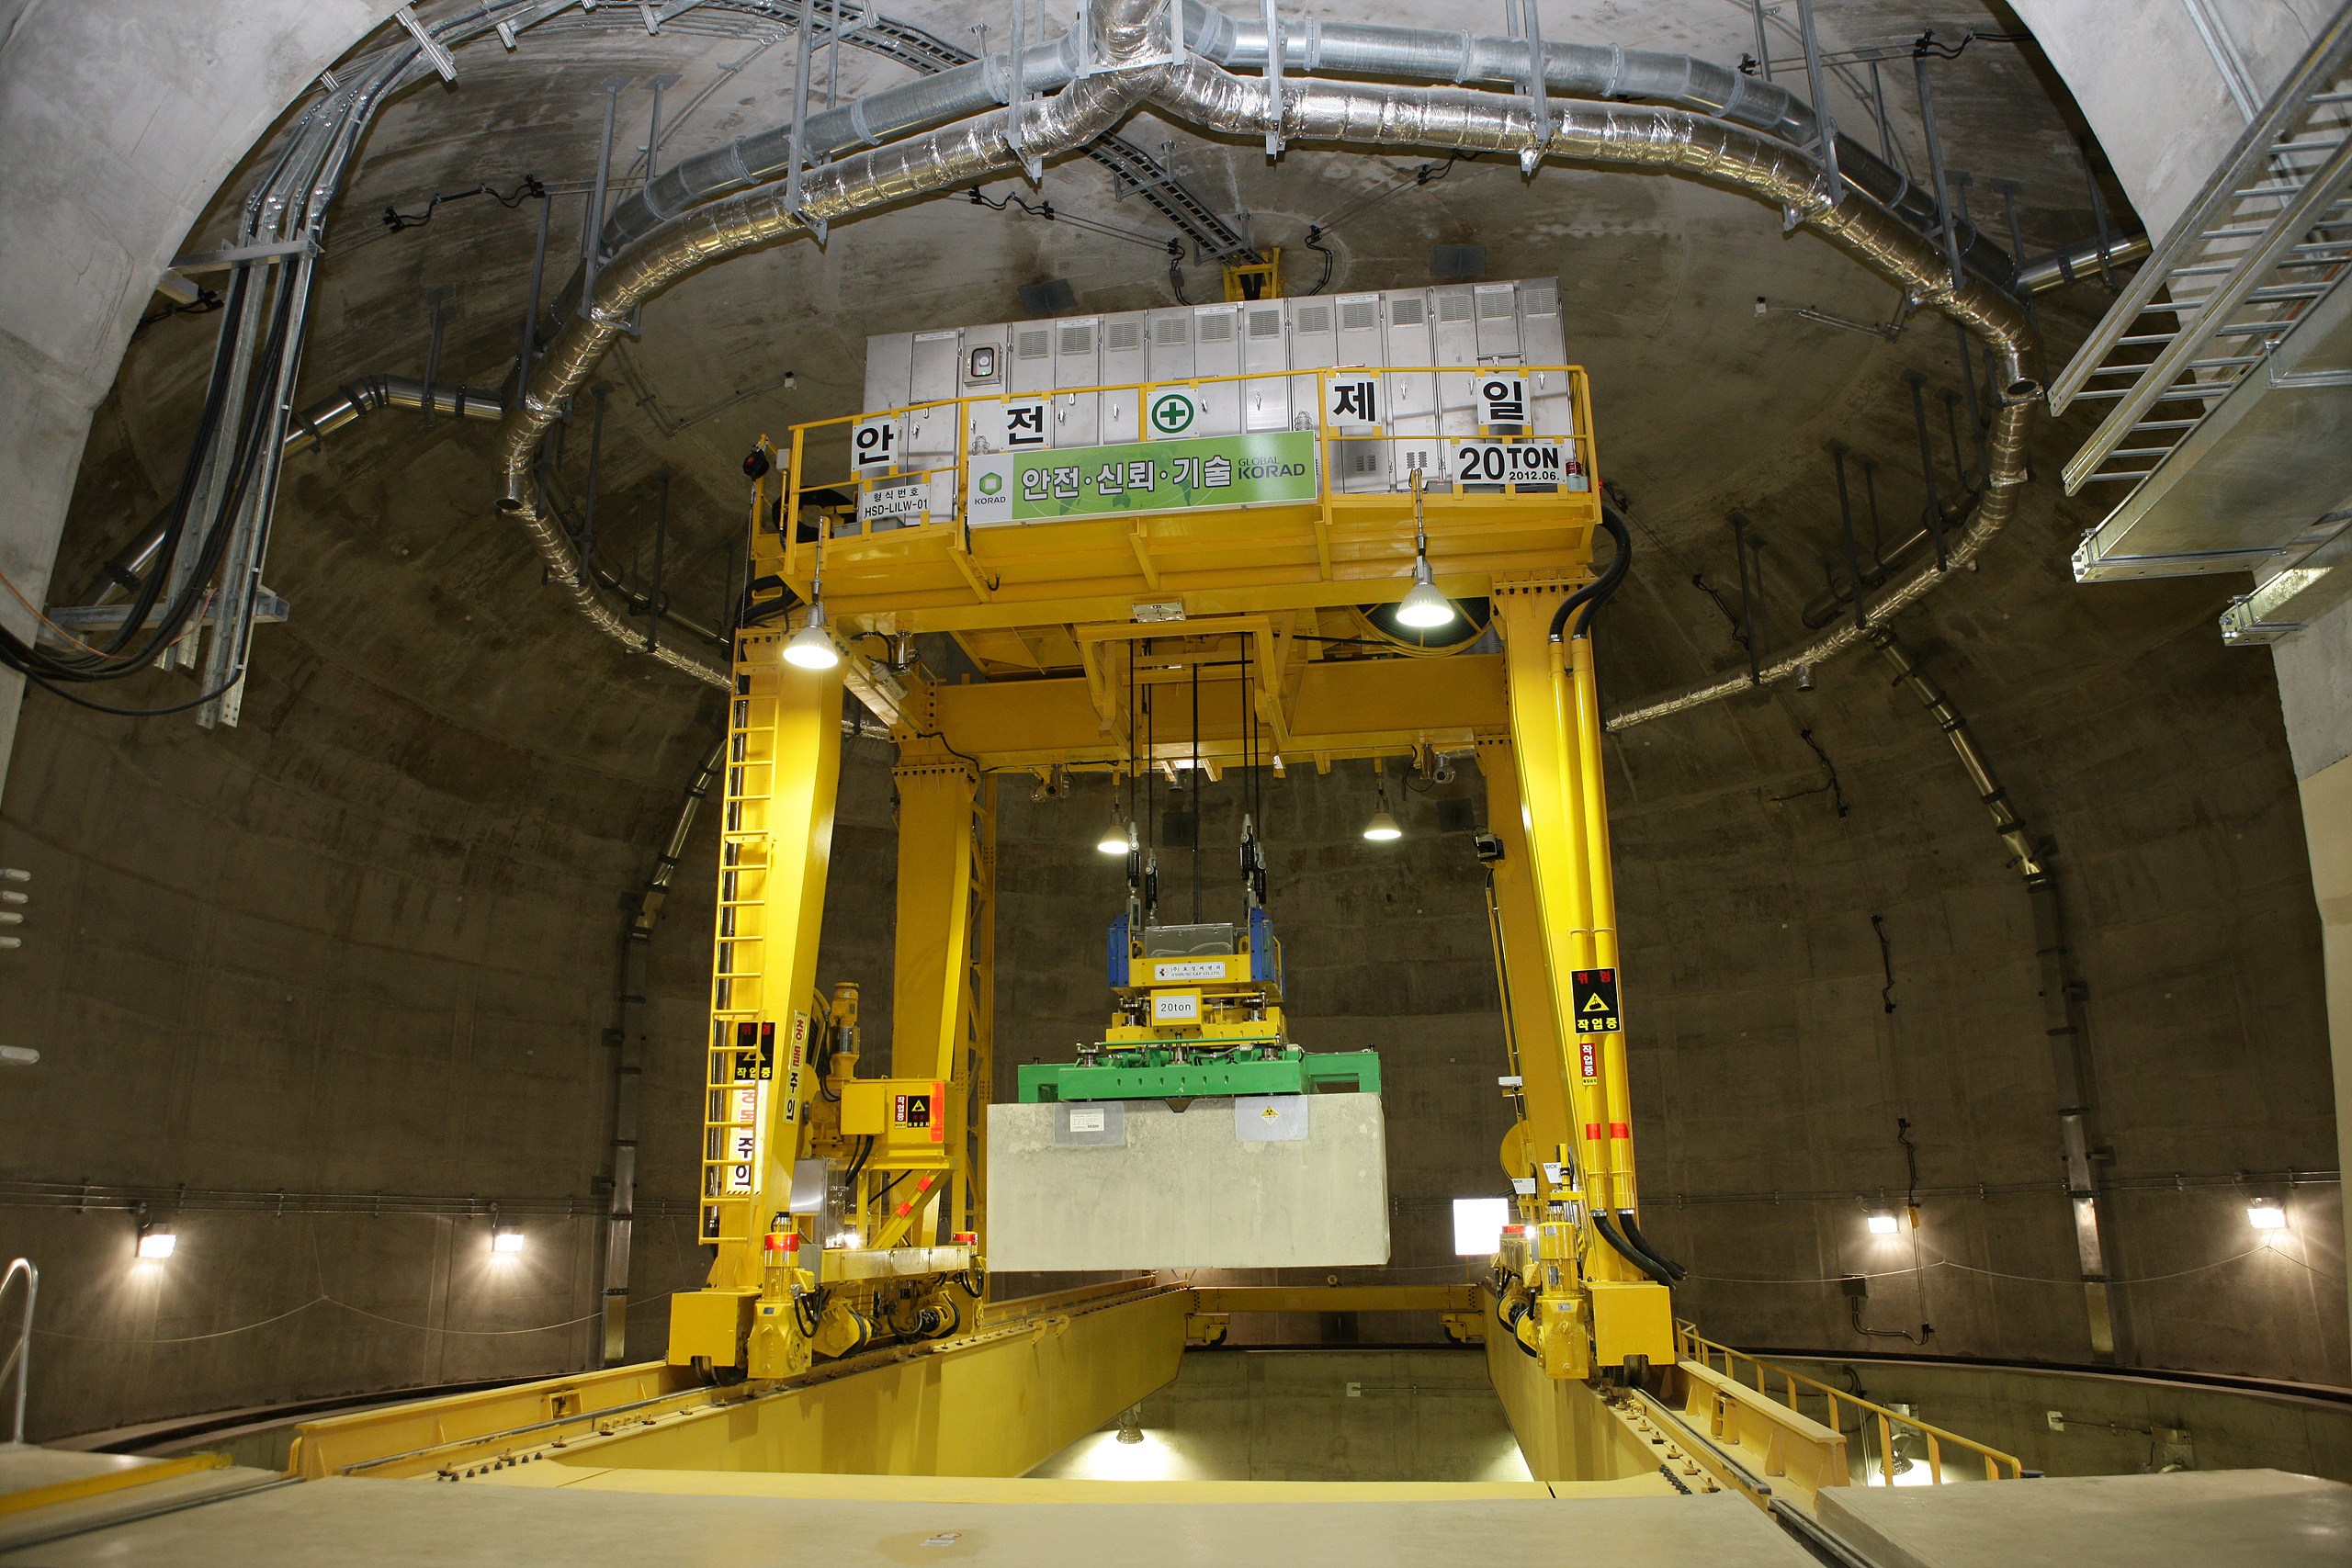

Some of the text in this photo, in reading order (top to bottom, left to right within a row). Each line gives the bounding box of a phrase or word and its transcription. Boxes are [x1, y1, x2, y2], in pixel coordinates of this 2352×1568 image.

[1238, 457, 1280, 467] GLOBAL
[1238, 463, 1306, 480] KORAD
[1509, 471, 1560, 480] 2012.06.
[974, 496, 1006, 505] KORAD
[865, 499, 929, 518] HSD-LILW-01
[1160, 1003, 1192, 1012] 20ton
